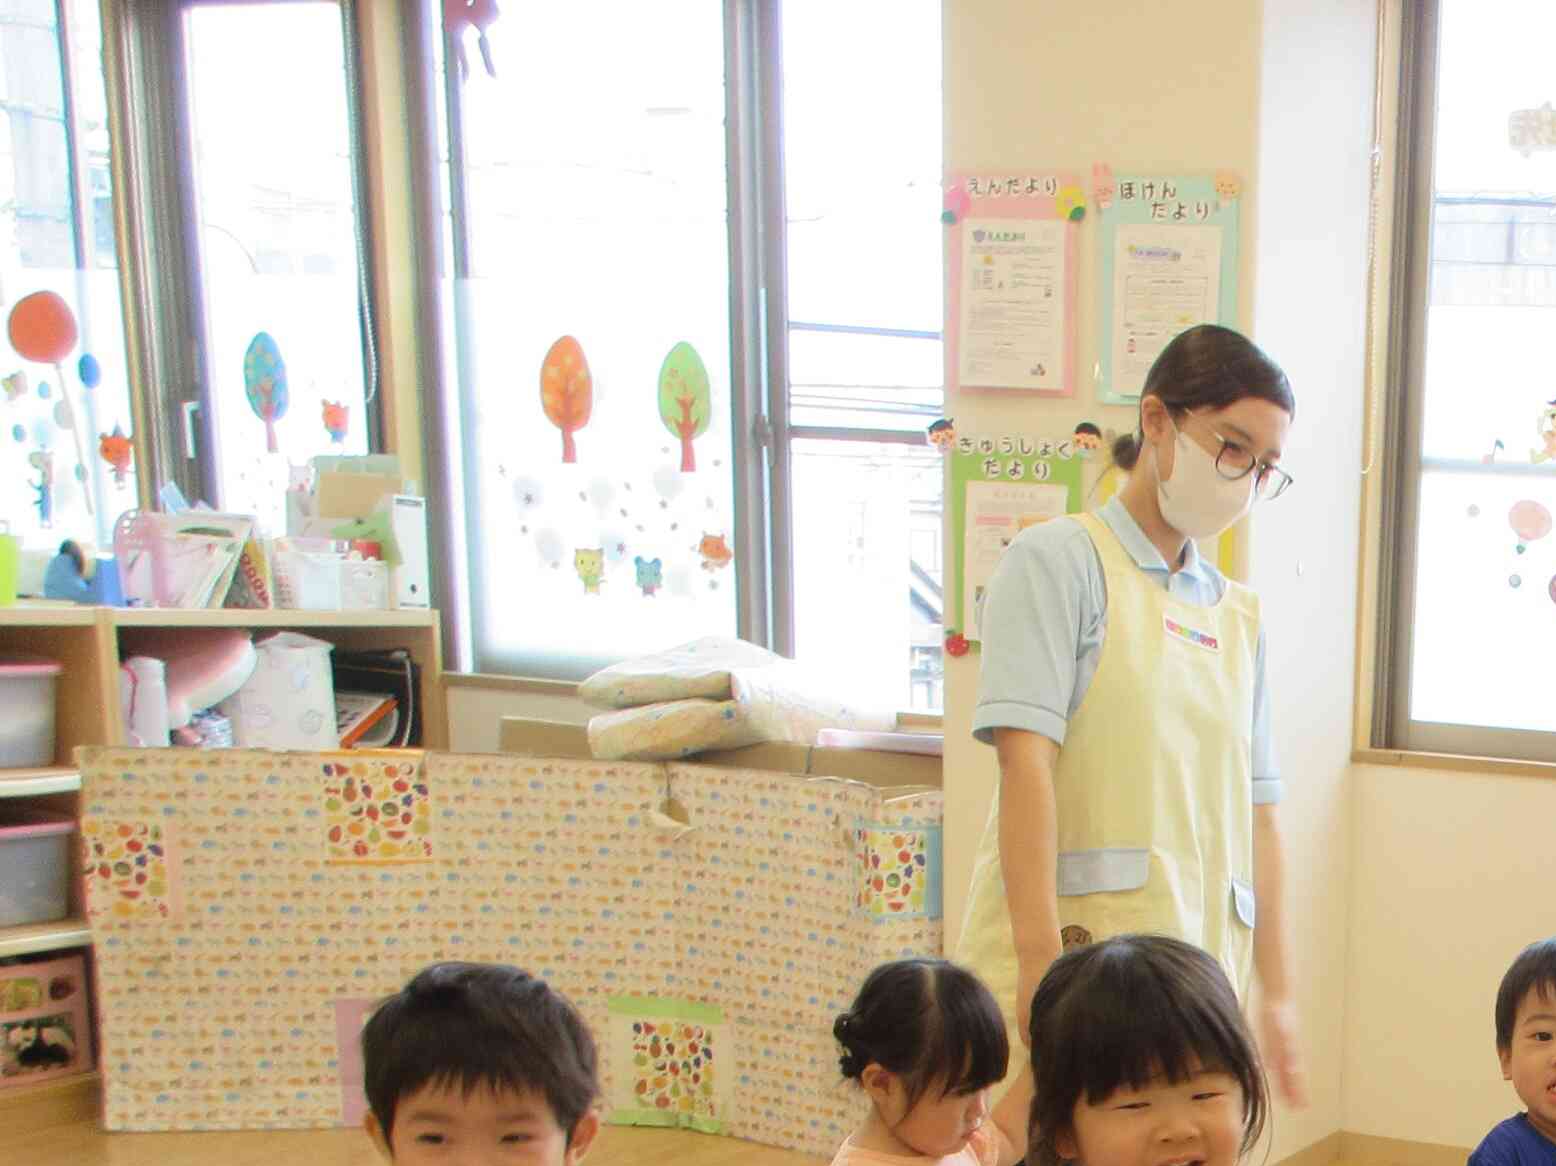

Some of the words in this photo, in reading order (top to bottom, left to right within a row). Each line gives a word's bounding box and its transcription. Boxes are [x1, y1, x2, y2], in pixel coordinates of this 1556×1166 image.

[967, 178, 1057, 196] えんだより
[1119, 181, 1177, 200] ほけん
[1151, 201, 1209, 220] だより
[959, 437, 1071, 459] きゅうしょく
[983, 460, 1049, 479] だより
